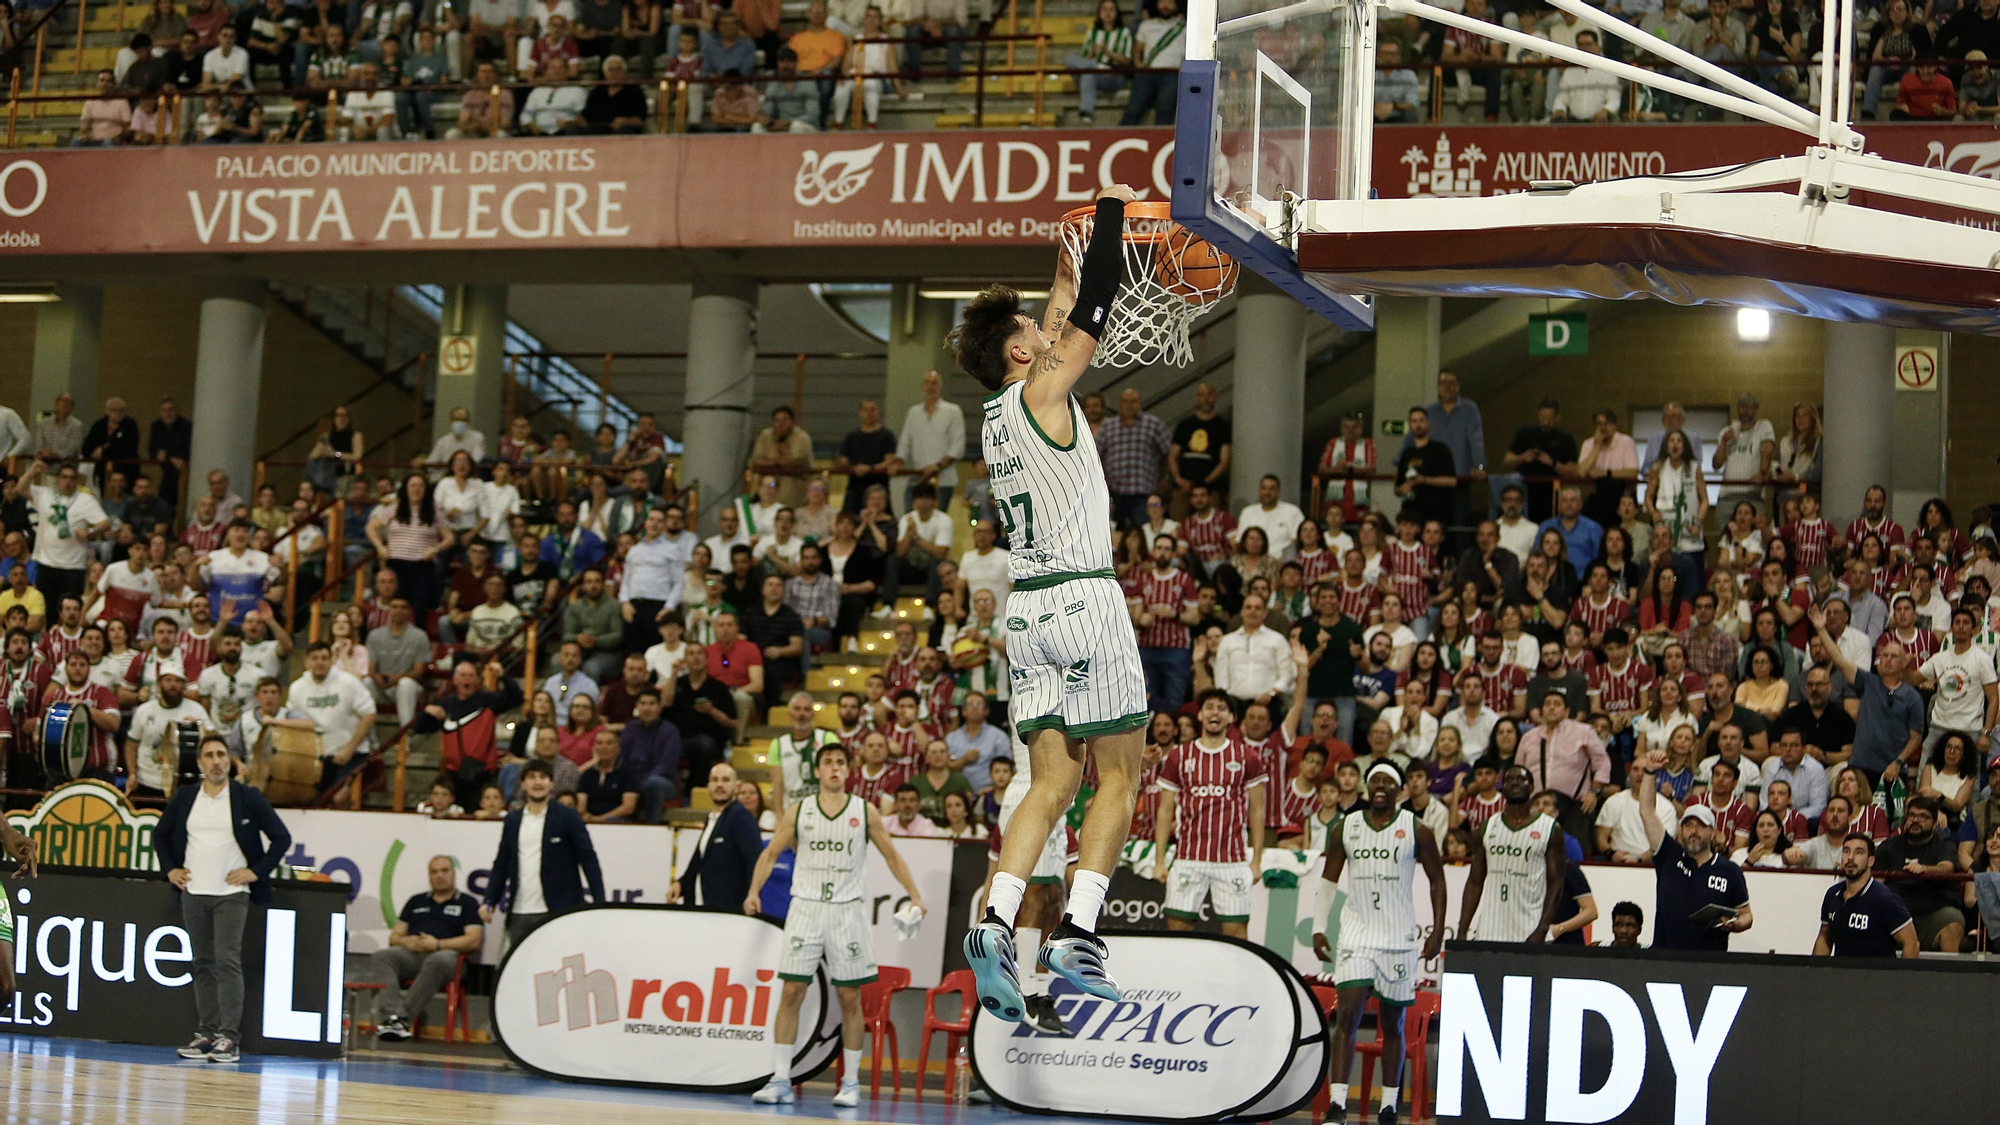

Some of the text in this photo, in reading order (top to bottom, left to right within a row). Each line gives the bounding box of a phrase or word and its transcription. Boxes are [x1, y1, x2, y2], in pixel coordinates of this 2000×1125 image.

[216, 147, 596, 179] PALACIO MUNICIPAL DEPORTES
[1493, 150, 1666, 182] AYUNTAMIENTO
[187, 181, 631, 245] VISTA ALEGRE
[794, 217, 877, 239] Instituto
[881, 218, 984, 241] Municipal
[988, 217, 1014, 237] de
[1546, 319, 1570, 349] D
[1064, 600, 1085, 614] PRO
[1008, 618, 1026, 630] Ford
[1064, 681, 1090, 691] REALE
[1190, 784, 1225, 797] coto
[809, 838, 844, 853] coto
[1353, 846, 1390, 859] coto
[1490, 845, 1522, 857] coto
[821, 882, 834, 900] 16
[1501, 883, 1508, 902] 8
[1707, 875, 1728, 893] CCB
[1372, 891, 1381, 910] 2
[1848, 912, 1869, 930] CCB
[627, 966, 775, 1027] rahi
[1122, 988, 1182, 1002] GRUPO
[623, 1023, 765, 1042] INSTALACIONES ELÉCTRICAS
[1085, 1000, 1260, 1047] PACC
[1435, 972, 1748, 1125] NDY
[1005, 1048, 1208, 1075] Correduría de Seguros
